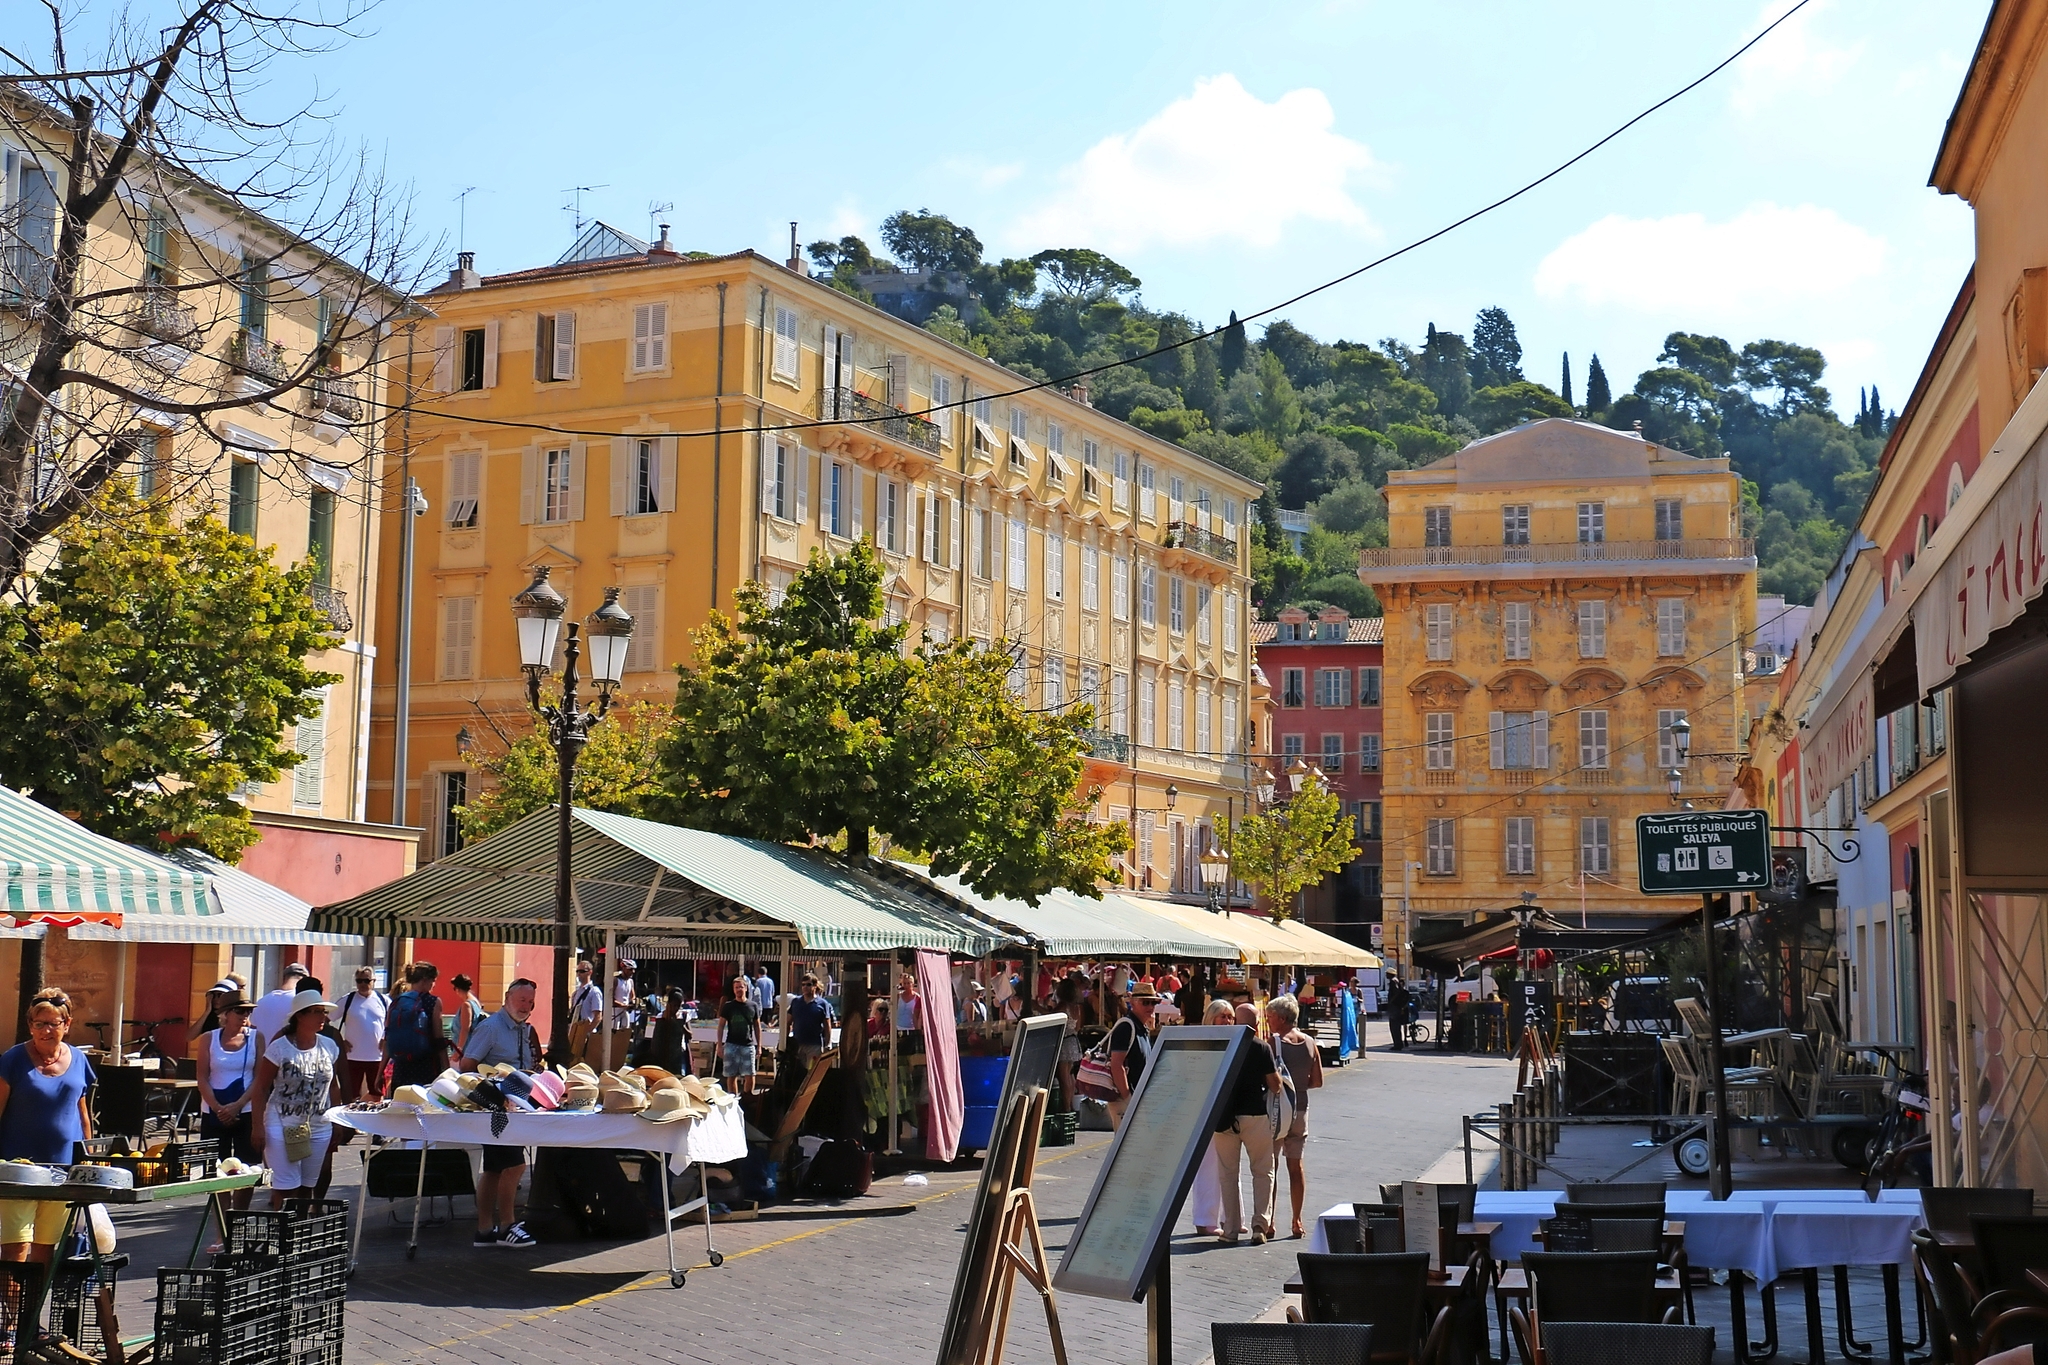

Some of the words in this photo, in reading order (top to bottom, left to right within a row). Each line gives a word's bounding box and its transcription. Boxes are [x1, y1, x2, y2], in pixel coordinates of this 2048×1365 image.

[1646, 824, 1698, 834] TOILETTES
[1700, 821, 1757, 832] PUBLIQUES
[1683, 833, 1721, 844] SALEYA
